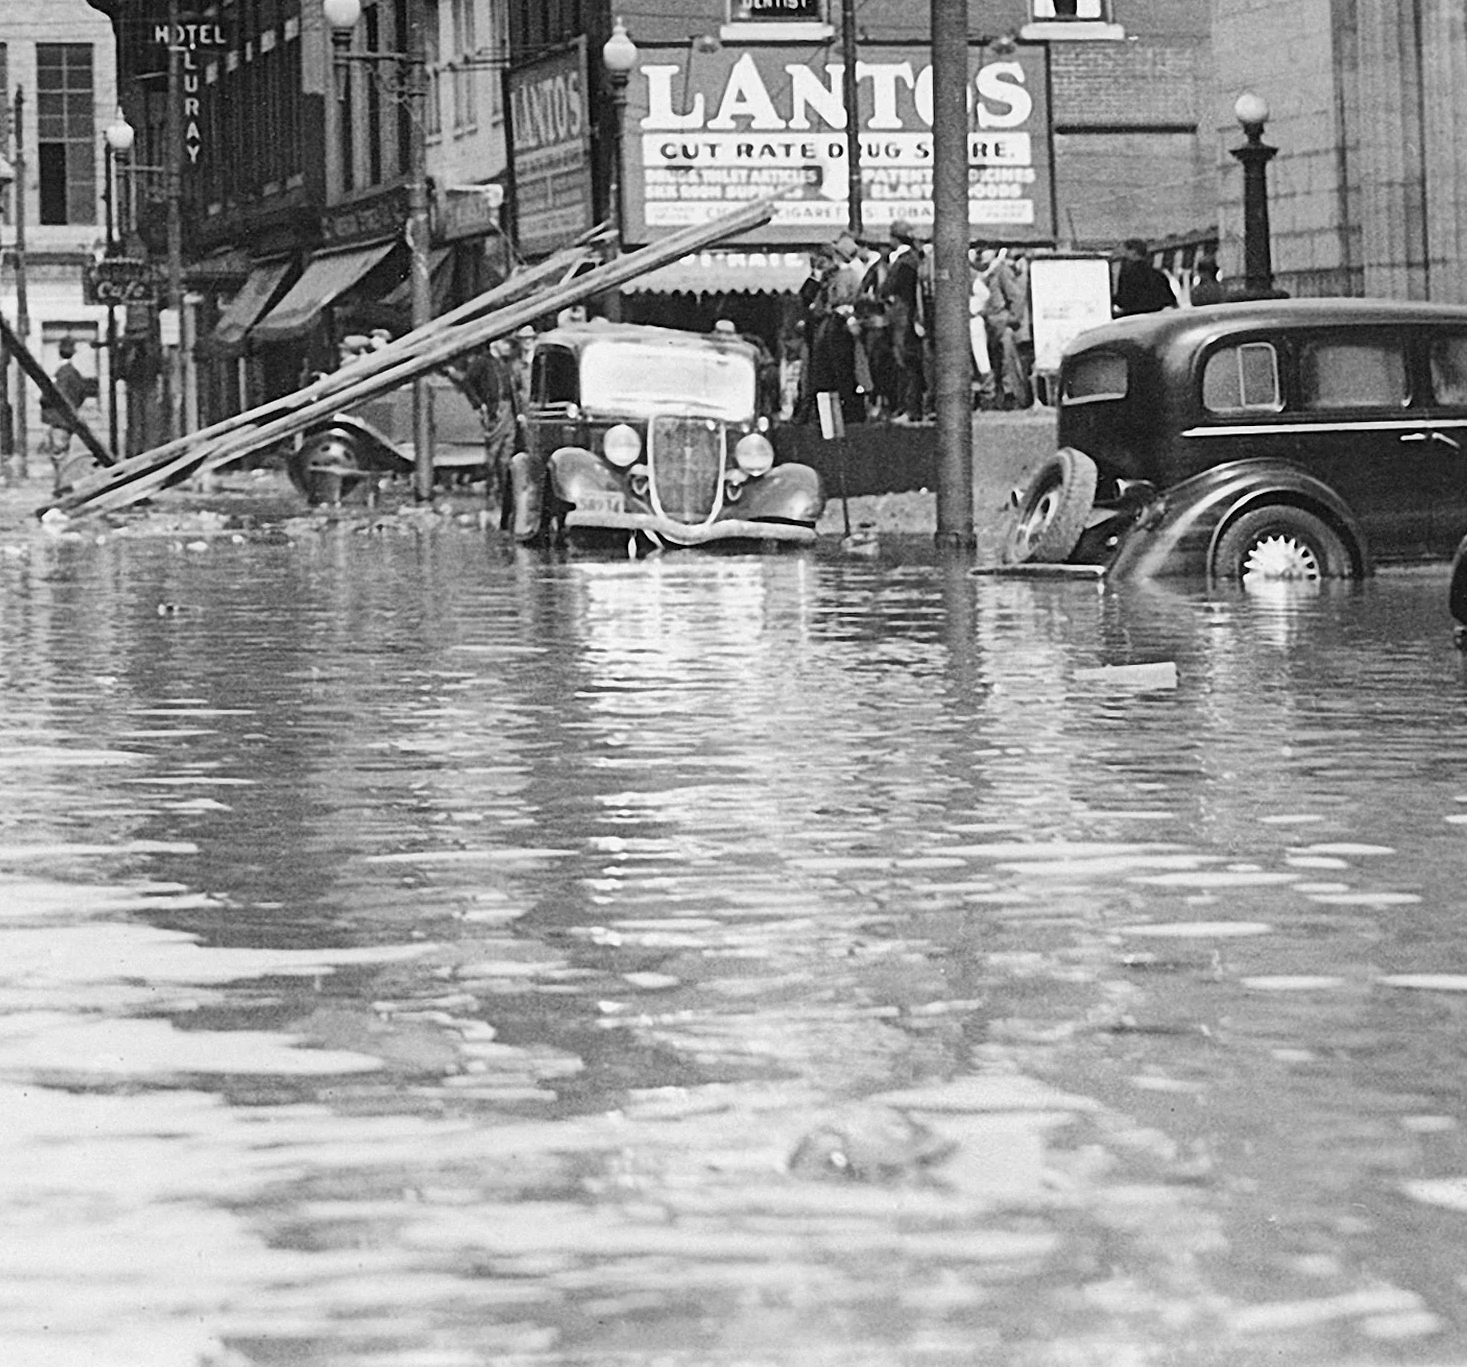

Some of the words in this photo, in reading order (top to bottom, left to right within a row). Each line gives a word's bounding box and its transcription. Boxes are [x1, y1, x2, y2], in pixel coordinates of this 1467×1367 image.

[155, 24, 227, 45] HOTEL
[184, 52, 201, 165] LURAY
[510, 70, 581, 151] LANTOS
[660, 143, 722, 160] CUT
[736, 143, 817, 159] RATE
[827, 142, 902, 159] DUG
[914, 141, 1016, 159] SRE.
